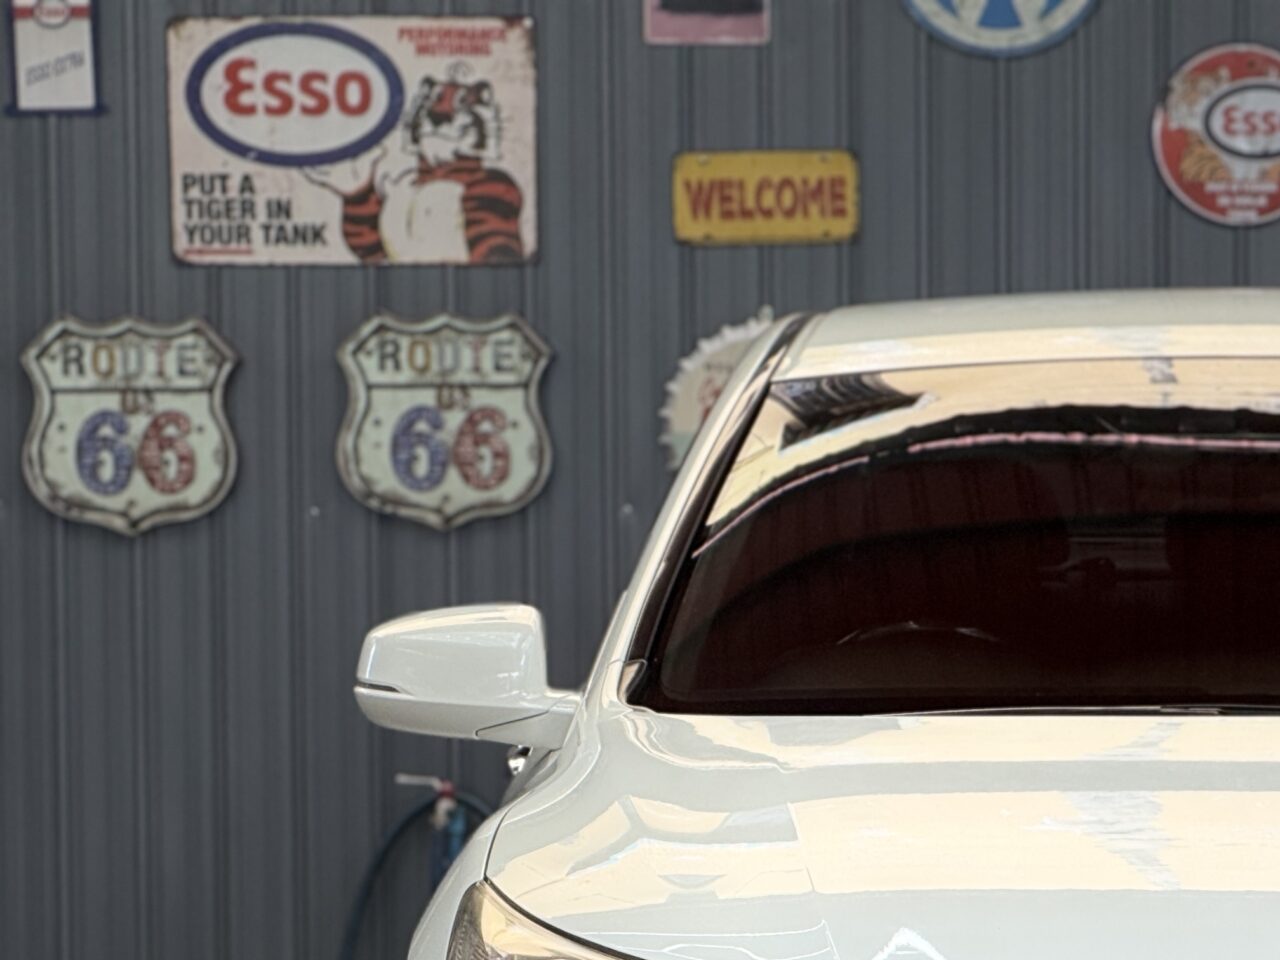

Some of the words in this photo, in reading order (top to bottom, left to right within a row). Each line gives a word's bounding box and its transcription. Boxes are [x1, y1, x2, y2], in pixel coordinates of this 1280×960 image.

[182, 172, 230, 195] PUT
[239, 172, 255, 195] A
[684, 176, 847, 221] WELCOME
[183, 197, 255, 221] TIGER
[266, 197, 292, 221] IN
[184, 222, 252, 246] YOUR
[260, 222, 328, 246] TANK
[62, 340, 200, 380] ROUTE
[377, 336, 516, 376] ROUTE
[76, 408, 197, 496] 66
[390, 403, 512, 492] 66
